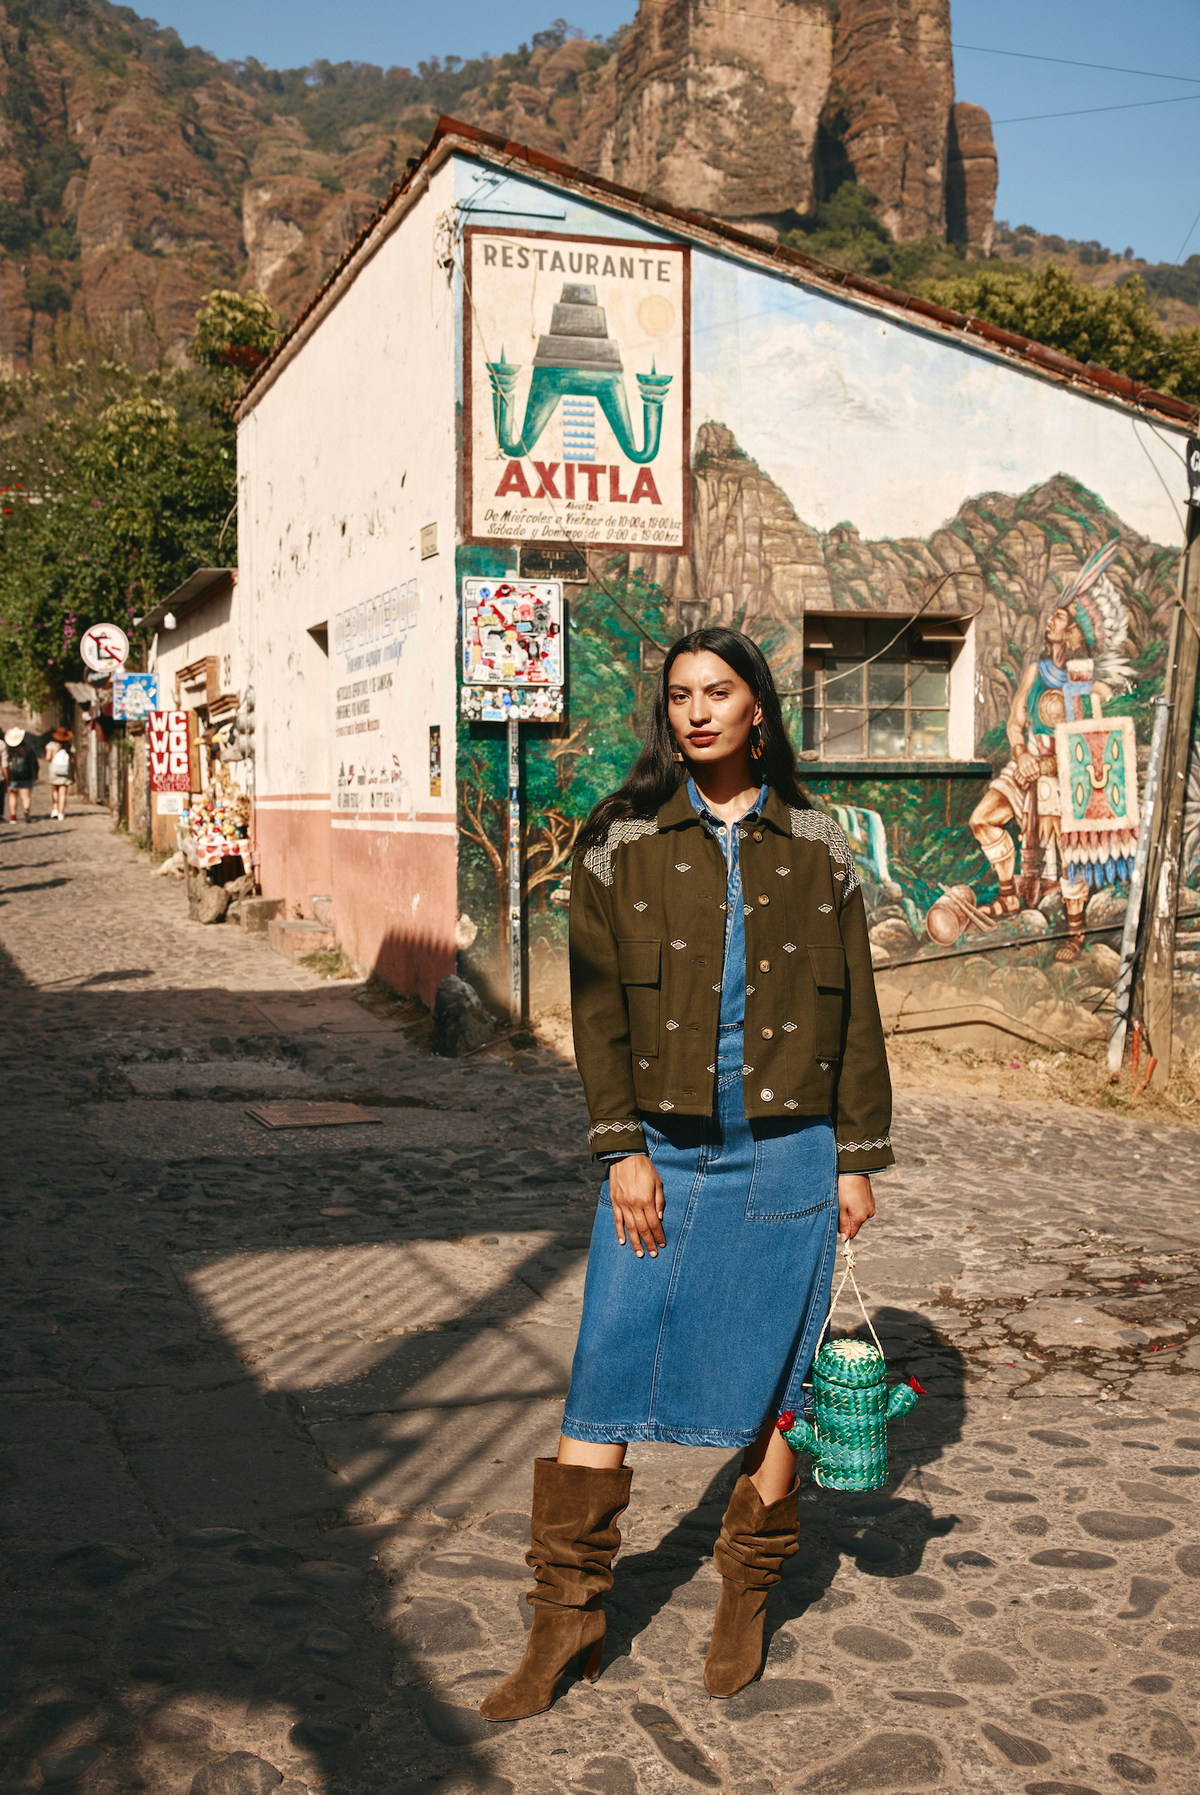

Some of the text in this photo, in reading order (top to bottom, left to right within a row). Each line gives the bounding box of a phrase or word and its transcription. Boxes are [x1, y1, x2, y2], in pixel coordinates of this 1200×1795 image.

[484, 244, 672, 282] RESTAURANTE
[494, 460, 663, 505] AXITLA
[484, 508, 499, 521] De
[566, 512, 603, 526] Viernes
[605, 515, 618, 527] de
[648, 516, 670, 529] 19:00
[530, 528, 539, 541] y
[588, 528, 601, 540] de
[606, 528, 629, 541] 9:00
[631, 532, 638, 541] a
[150, 711, 187, 732] WC
[150, 731, 188, 753] WC
[150, 752, 189, 775] WC
